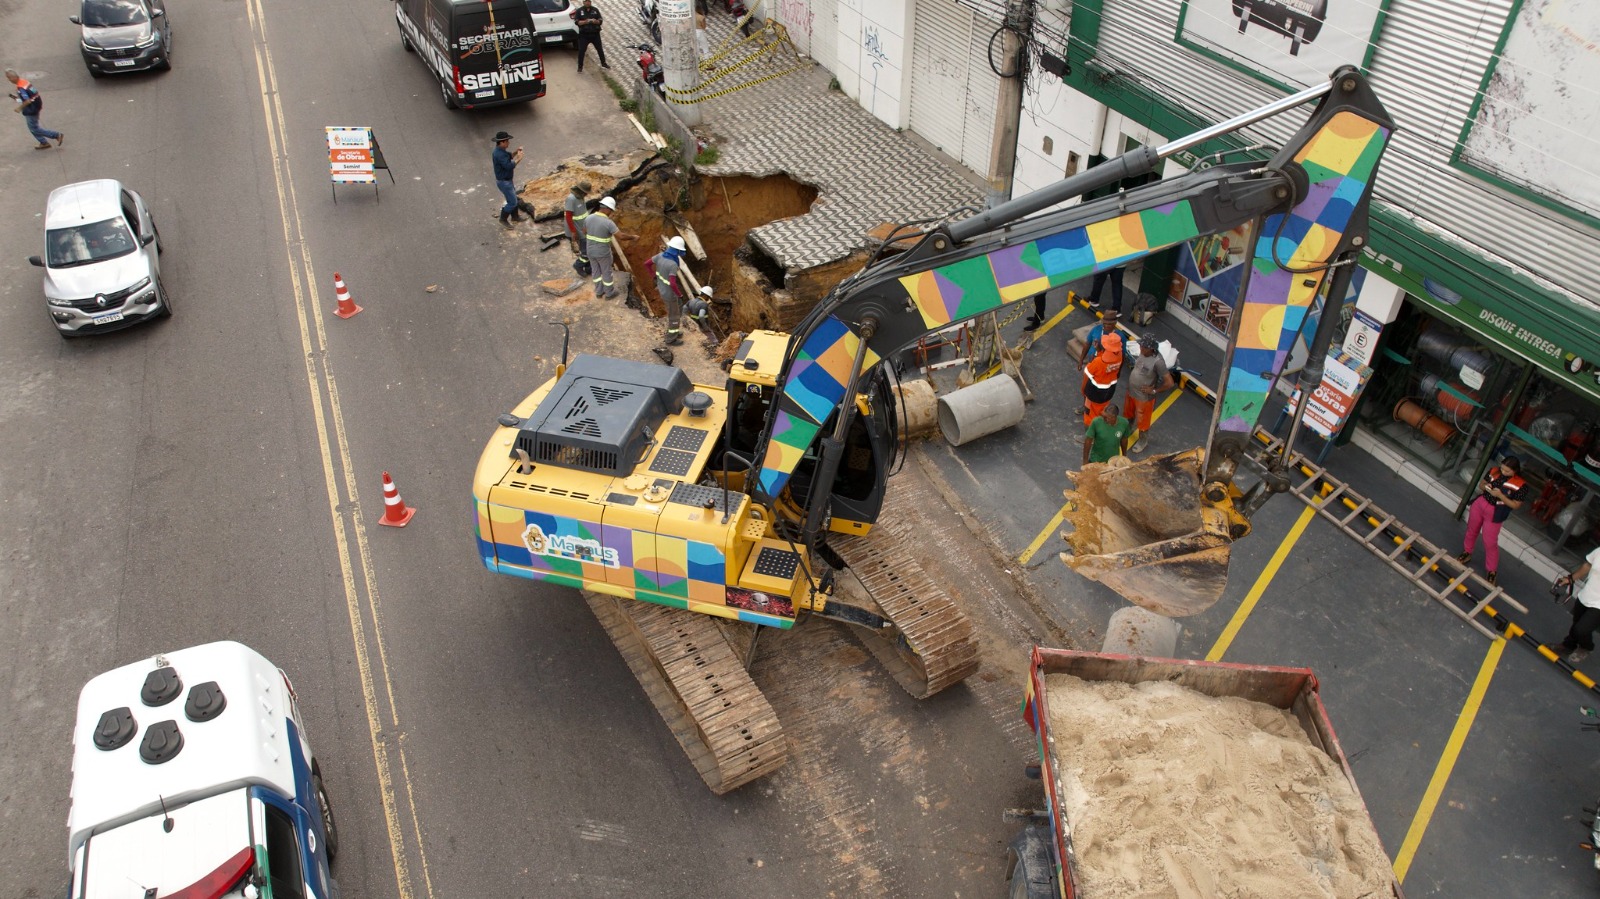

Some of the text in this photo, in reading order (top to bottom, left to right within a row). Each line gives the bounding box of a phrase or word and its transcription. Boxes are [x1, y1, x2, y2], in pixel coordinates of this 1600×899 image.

[459, 28, 530, 45] SECRETARIA
[469, 35, 533, 55] OBRAS
[1356, 334, 1366, 346] E
[1479, 309, 1563, 359] DISQUE ENTREGA
[1314, 388, 1347, 414] Obras
[551, 536, 614, 559] Maaus
